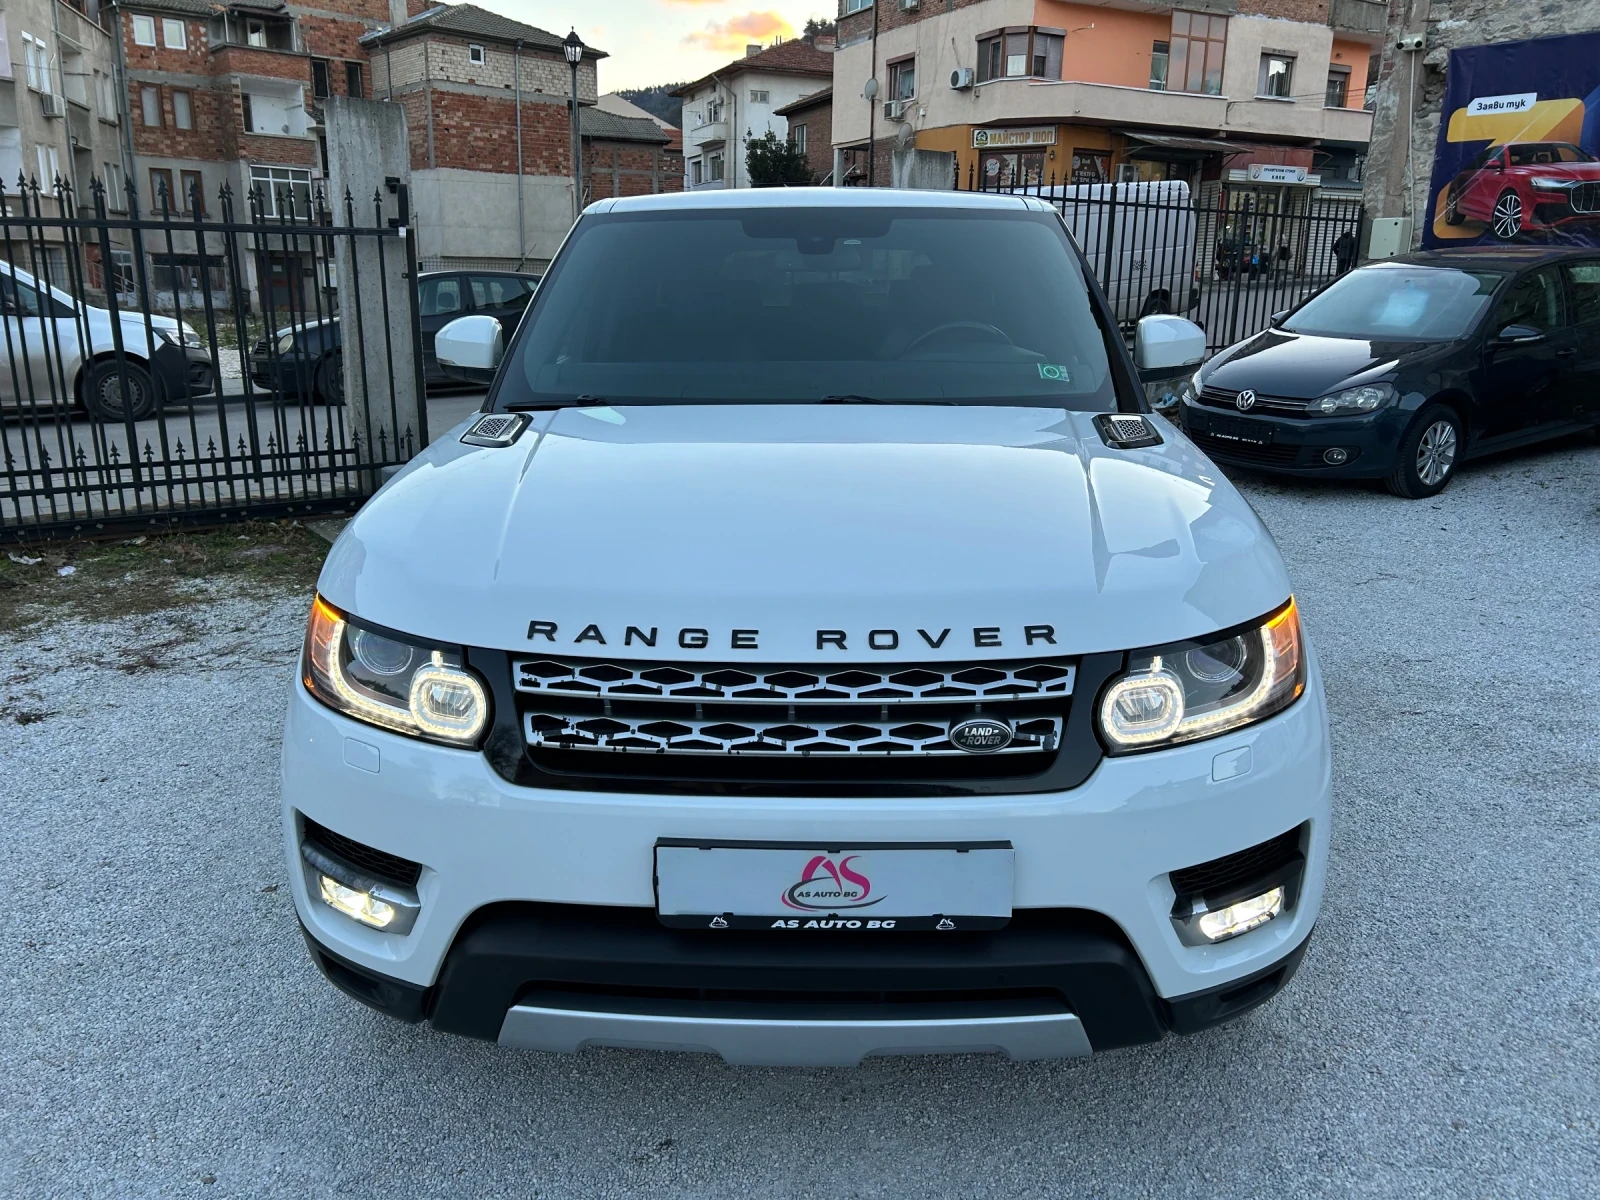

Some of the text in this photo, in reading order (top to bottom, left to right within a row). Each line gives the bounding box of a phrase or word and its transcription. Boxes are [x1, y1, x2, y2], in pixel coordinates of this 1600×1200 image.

[1476, 99, 1526, 111] Заяви тук
[989, 130, 1054, 145] МАЙСТОР ШОП
[527, 620, 1057, 650] RANGE ROVER
[964, 727, 993, 737] LAND
[966, 736, 1002, 746] ROVER
[801, 855, 871, 902] AS
[771, 919, 896, 929] AS AUTO BG
